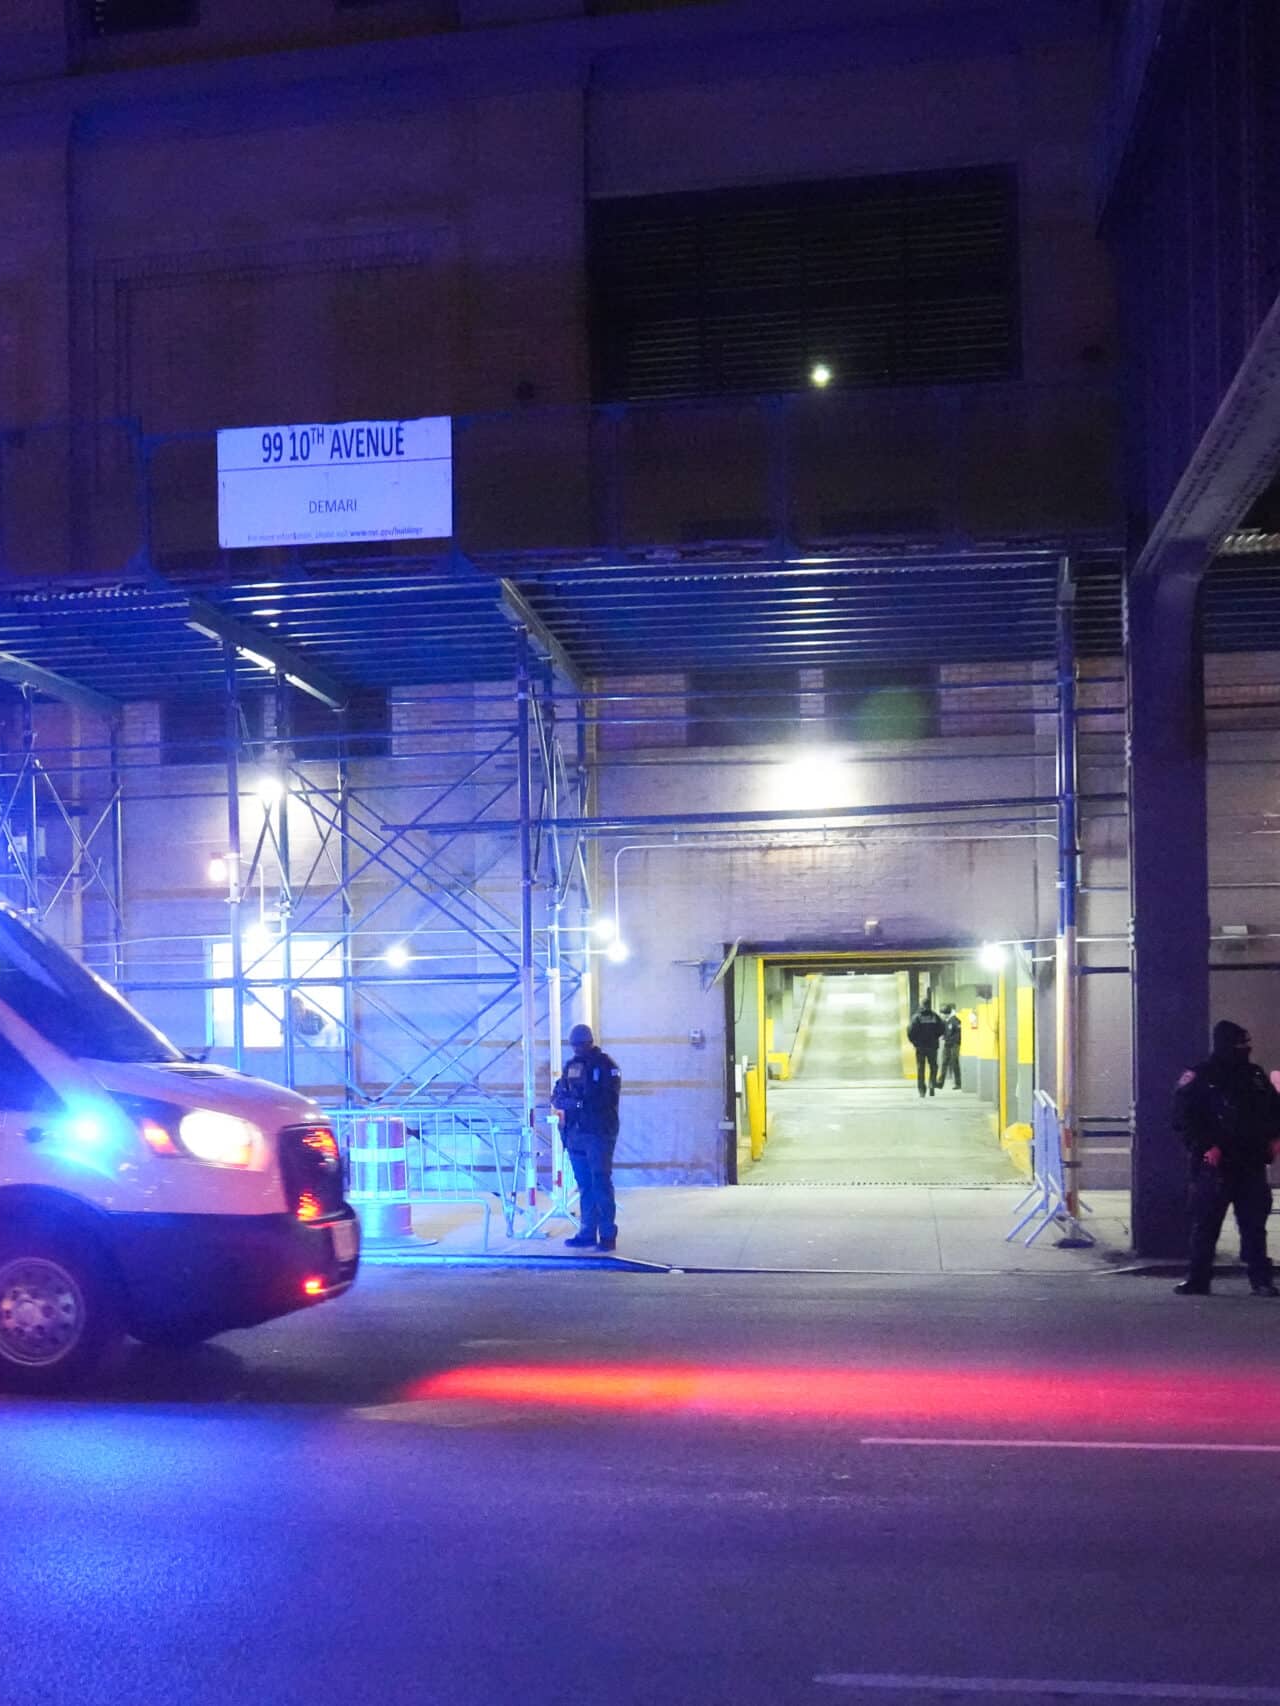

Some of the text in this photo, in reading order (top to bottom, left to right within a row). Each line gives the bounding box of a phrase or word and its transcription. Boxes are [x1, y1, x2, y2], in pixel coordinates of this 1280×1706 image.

[262, 432, 283, 463] 99
[330, 426, 405, 459] AVENUE
[308, 499, 357, 514] DEMARI
